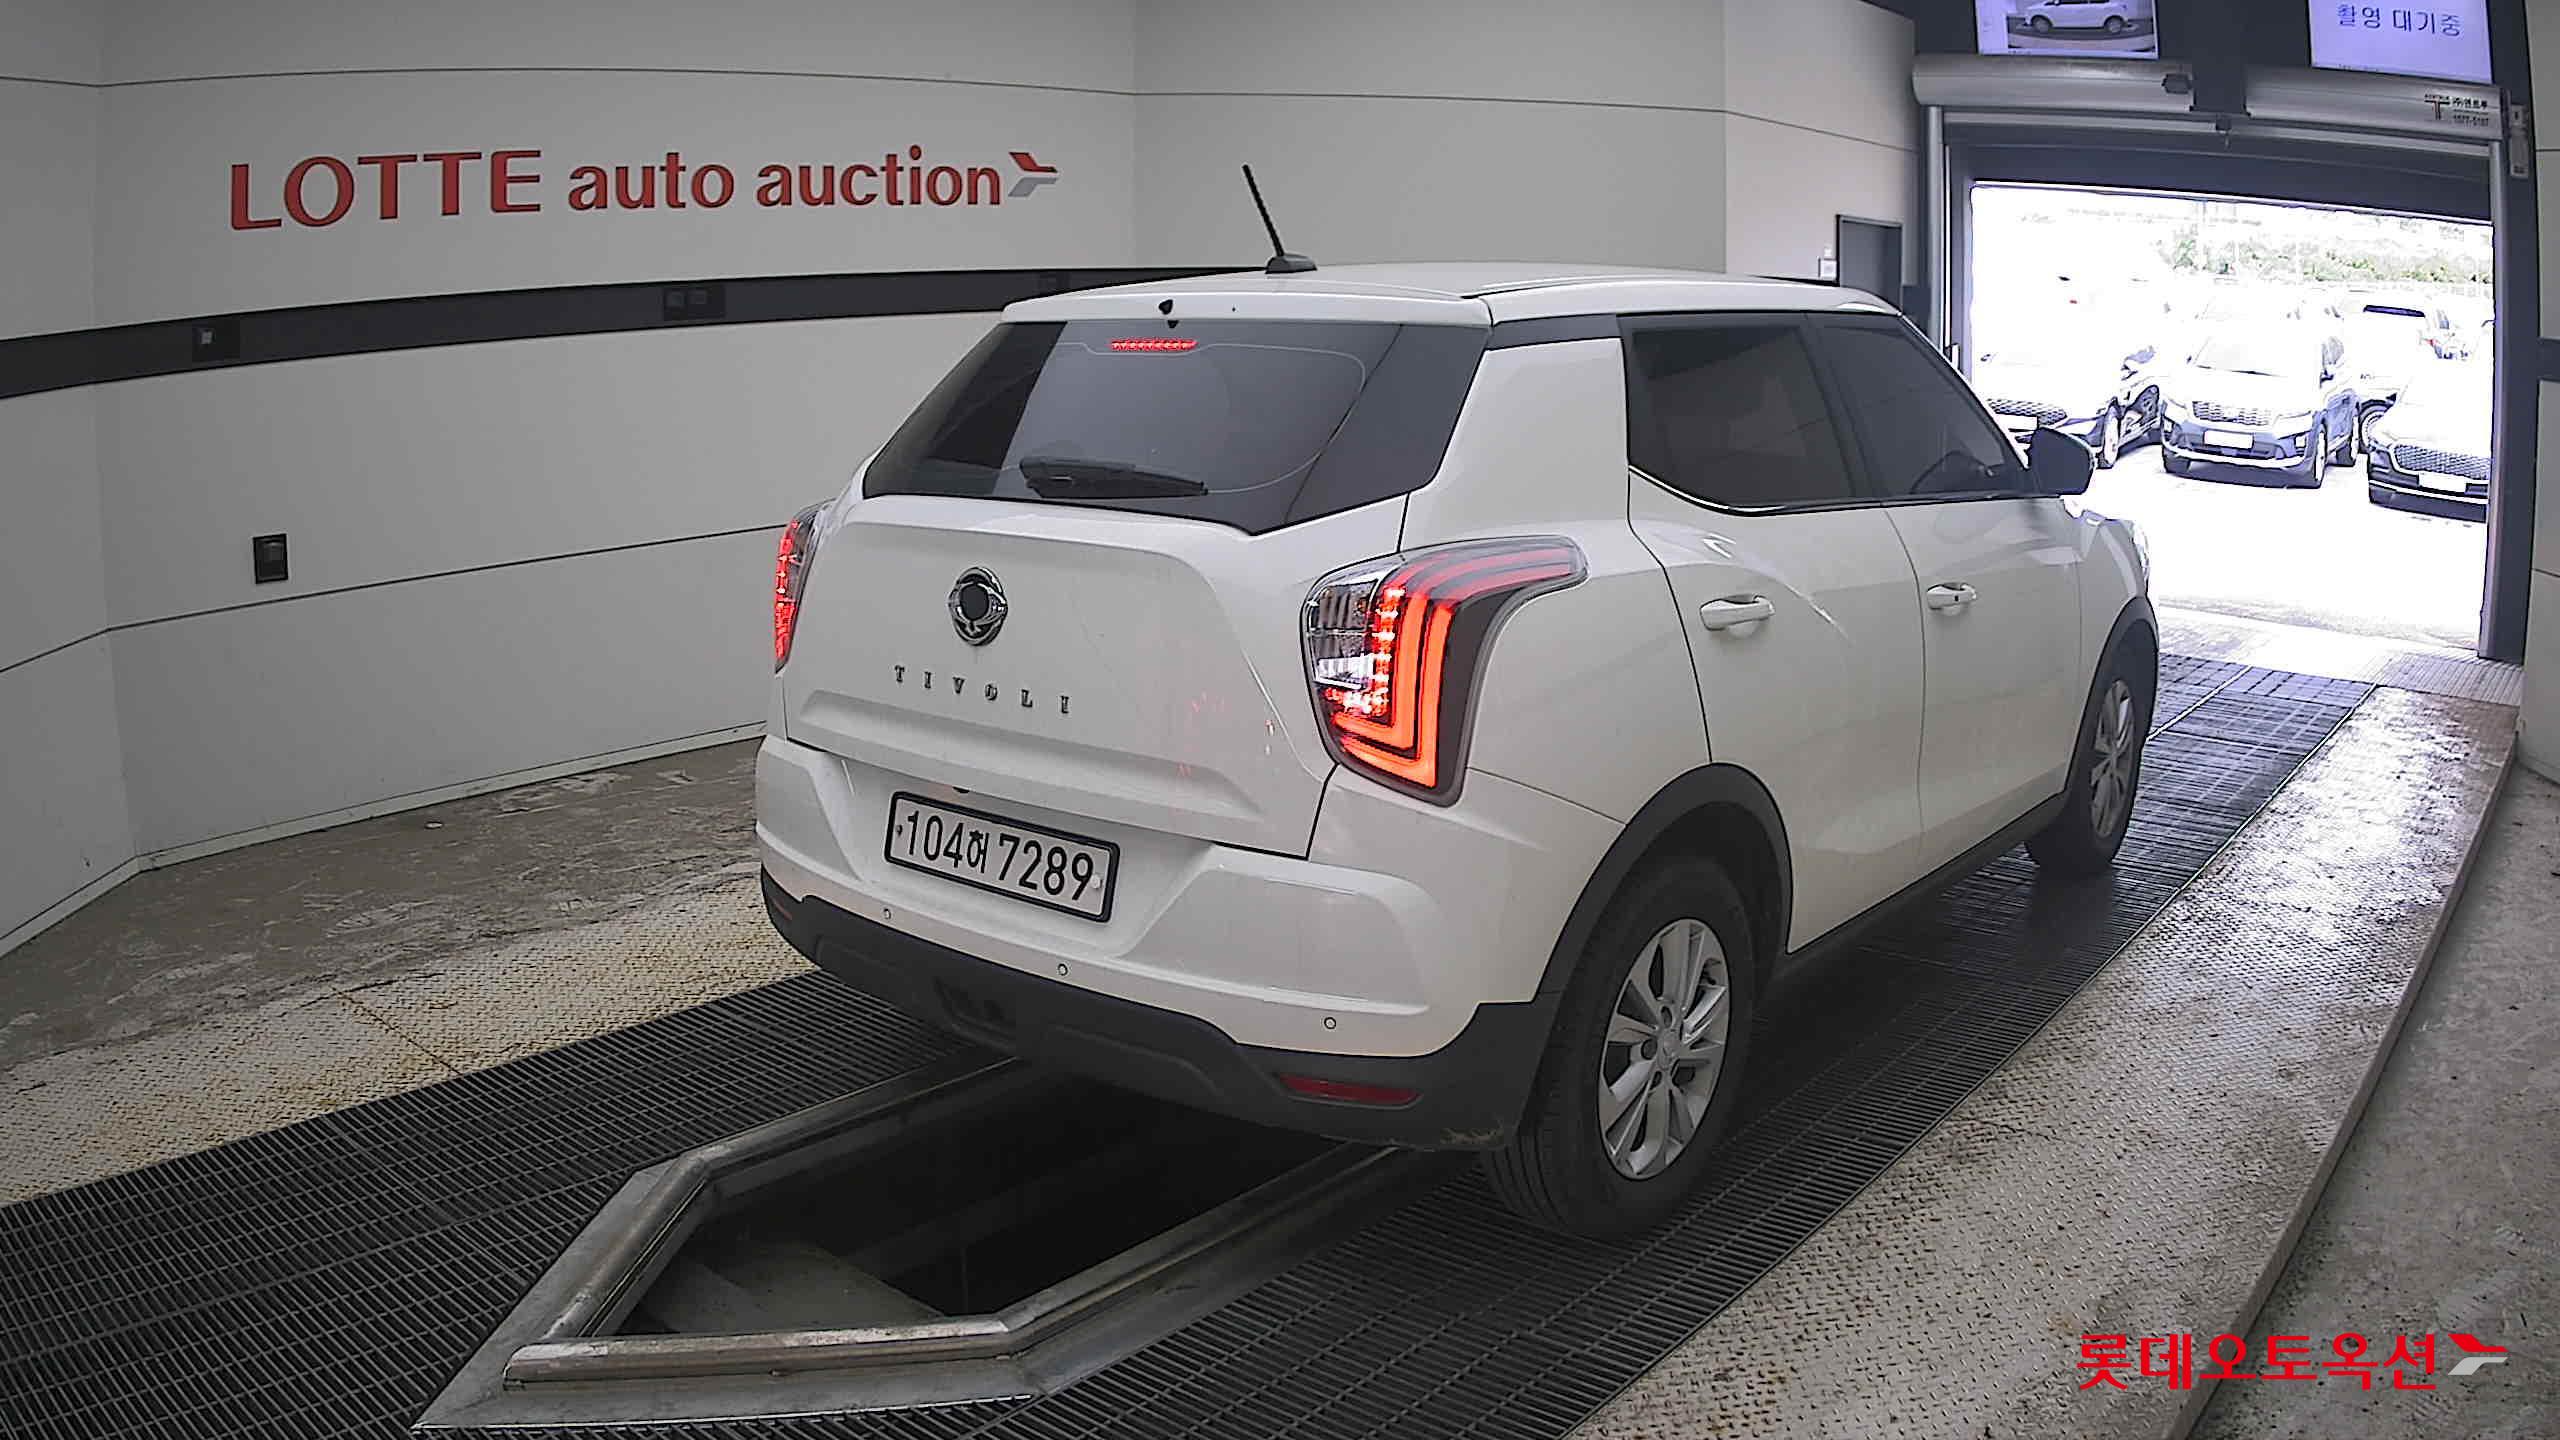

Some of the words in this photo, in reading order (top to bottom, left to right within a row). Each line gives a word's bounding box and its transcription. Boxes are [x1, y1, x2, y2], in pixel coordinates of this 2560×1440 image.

[2393, 9, 2461, 37] 대기중
[231, 149, 541, 231] LOTTE
[567, 152, 735, 211] auto
[756, 144, 1001, 207] auction
[894, 664, 1070, 715] TIVOLI
[907, 810, 990, 874] 104허
[998, 832, 1094, 901] 7289
